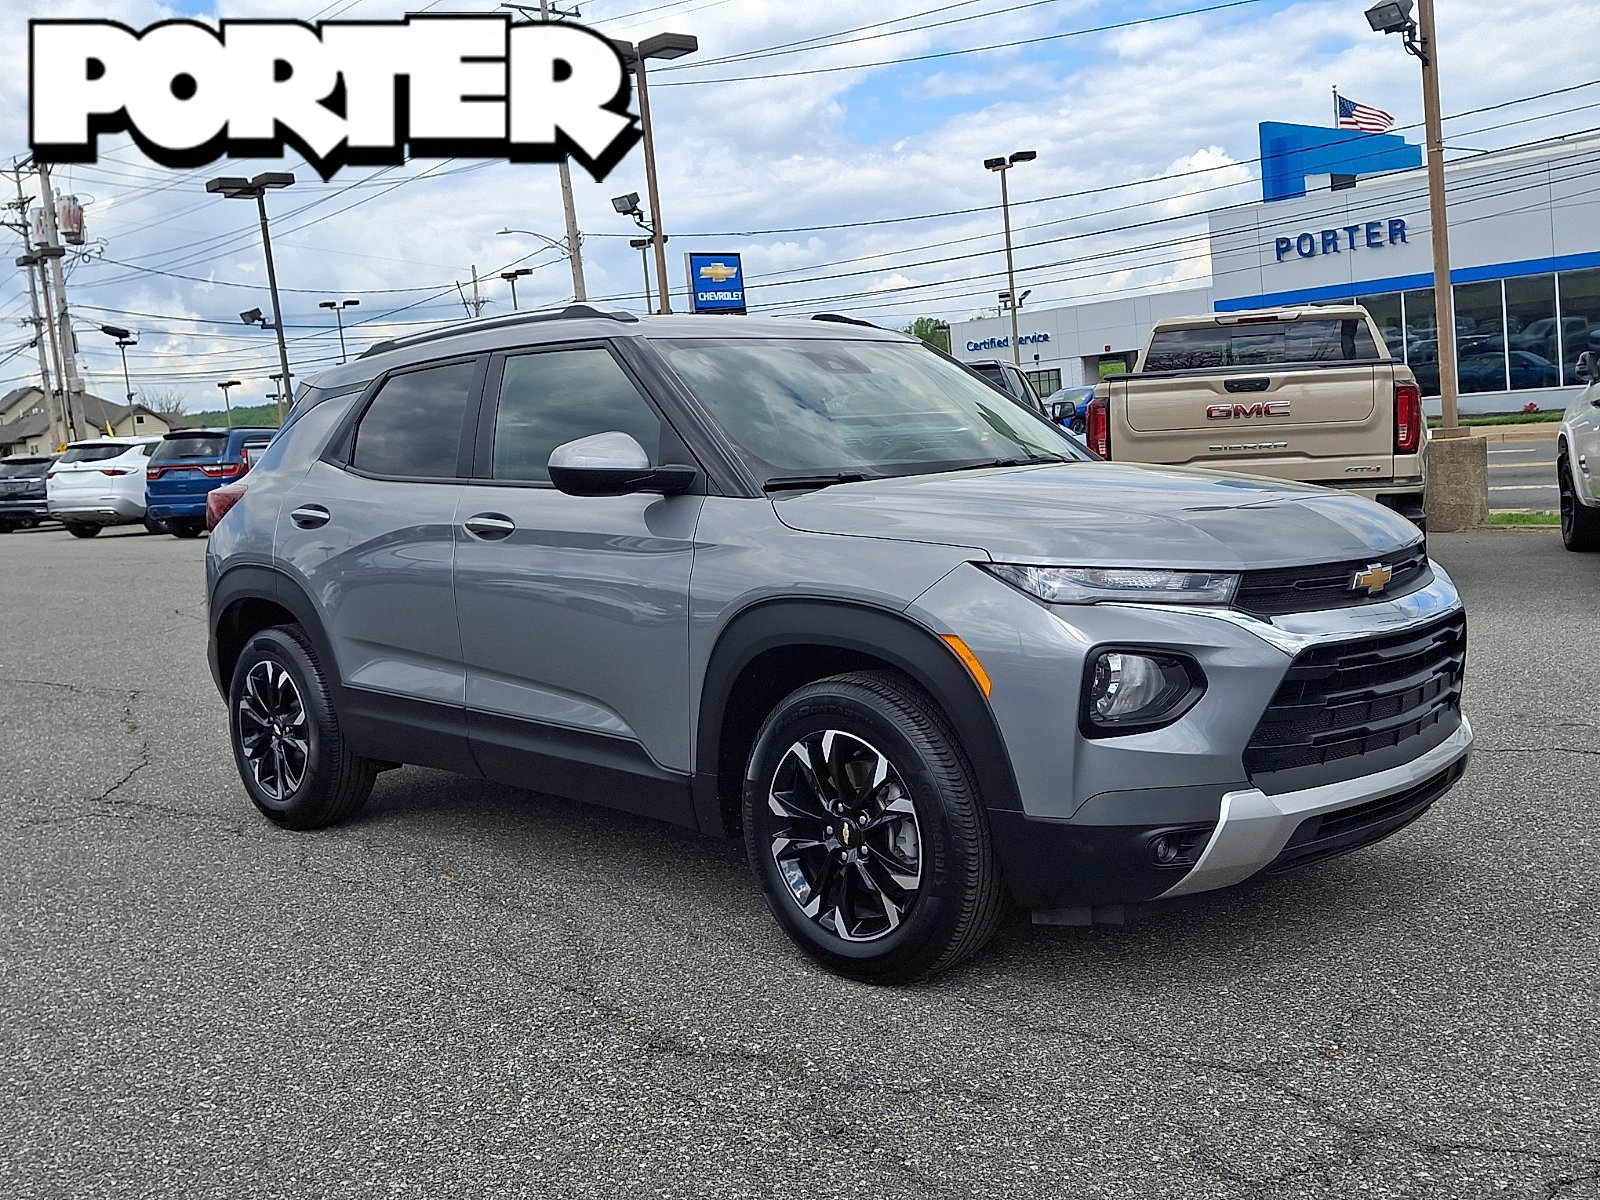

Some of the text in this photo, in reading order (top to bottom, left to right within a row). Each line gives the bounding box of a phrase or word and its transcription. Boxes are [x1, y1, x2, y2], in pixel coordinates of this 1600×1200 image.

[1275, 219, 1408, 262] PORTER
[698, 291, 742, 301] CHEVROLET
[966, 335, 1009, 352] Certified
[1206, 400, 1291, 420] GMC
[1208, 441, 1288, 451] SIERRA
